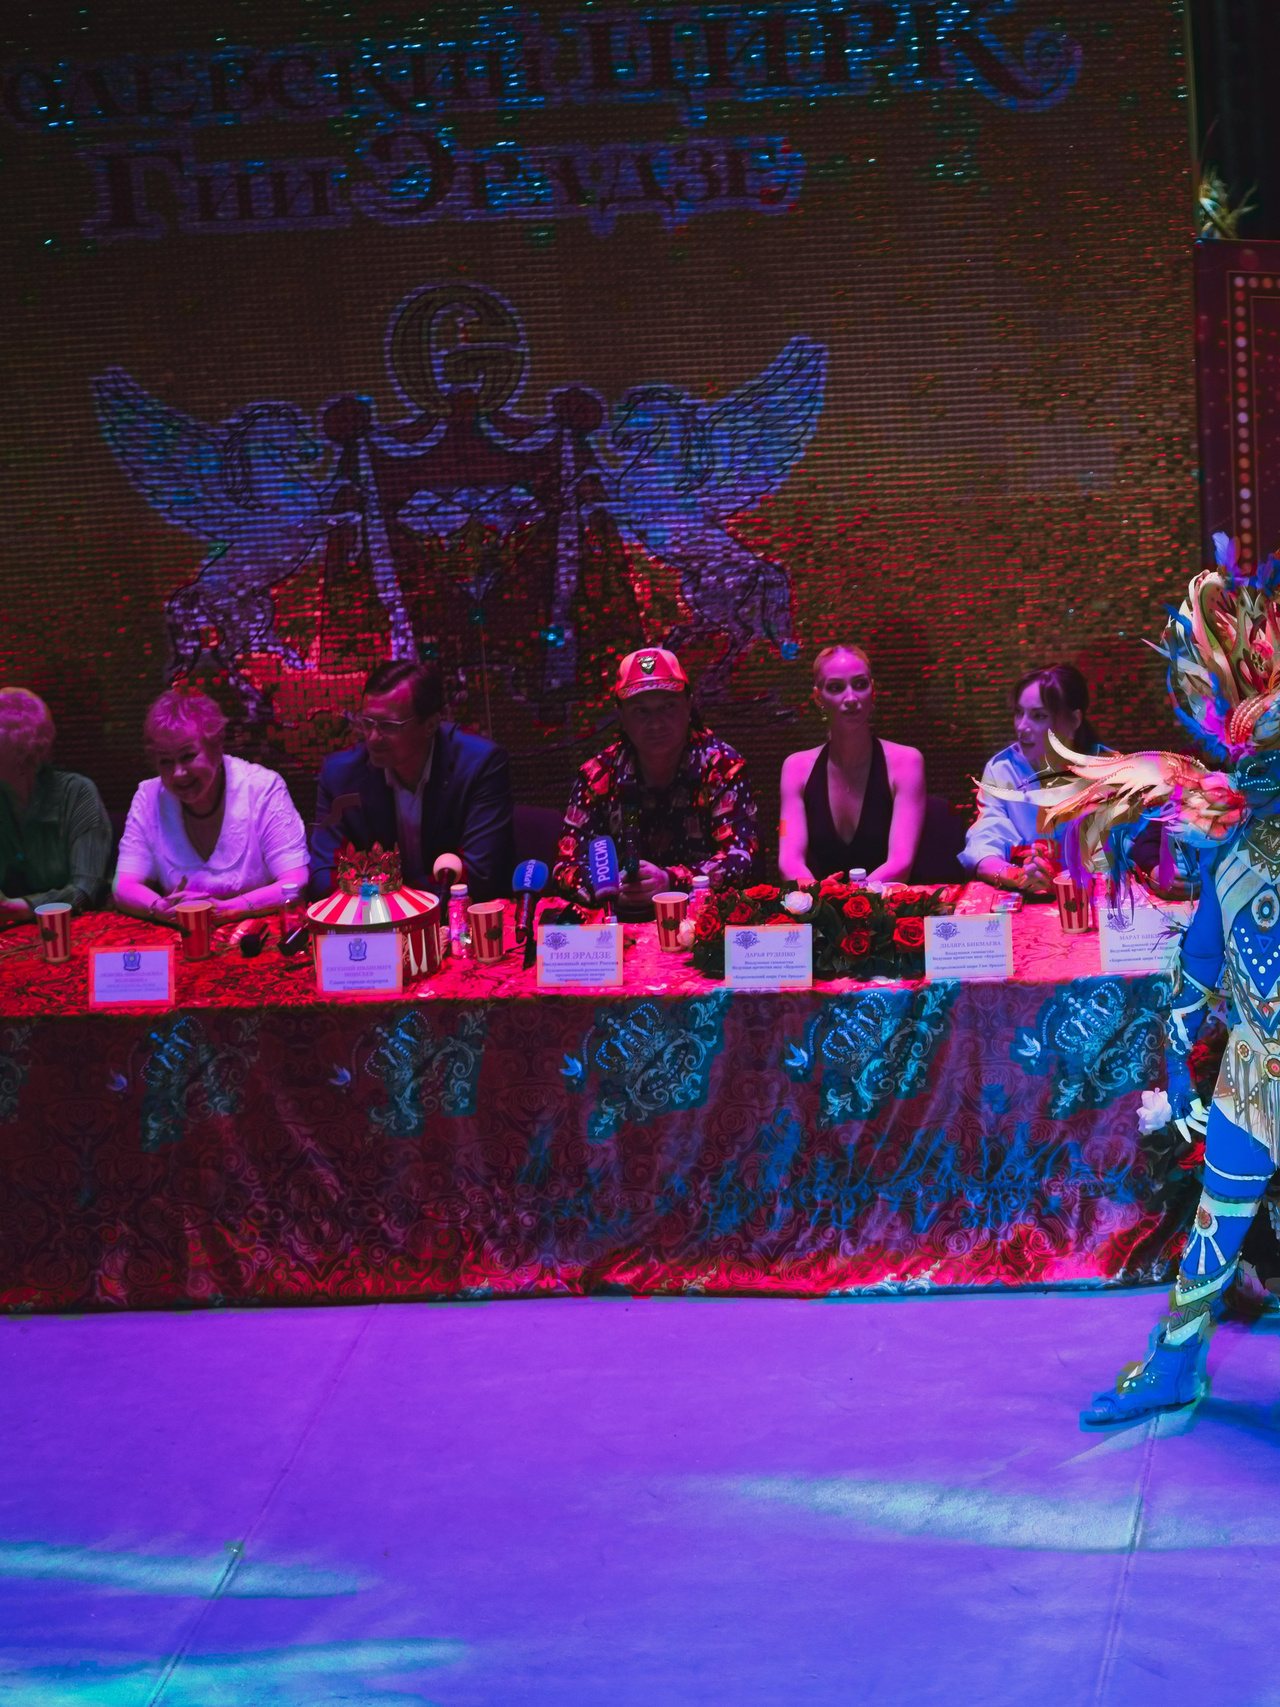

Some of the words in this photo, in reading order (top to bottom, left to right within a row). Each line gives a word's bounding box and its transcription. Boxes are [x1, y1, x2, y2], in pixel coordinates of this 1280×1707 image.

[593, 838, 611, 883] РОССИЯ
[550, 952, 571, 960] ГИЯ
[572, 951, 612, 960] ЭРАДЗЕ
